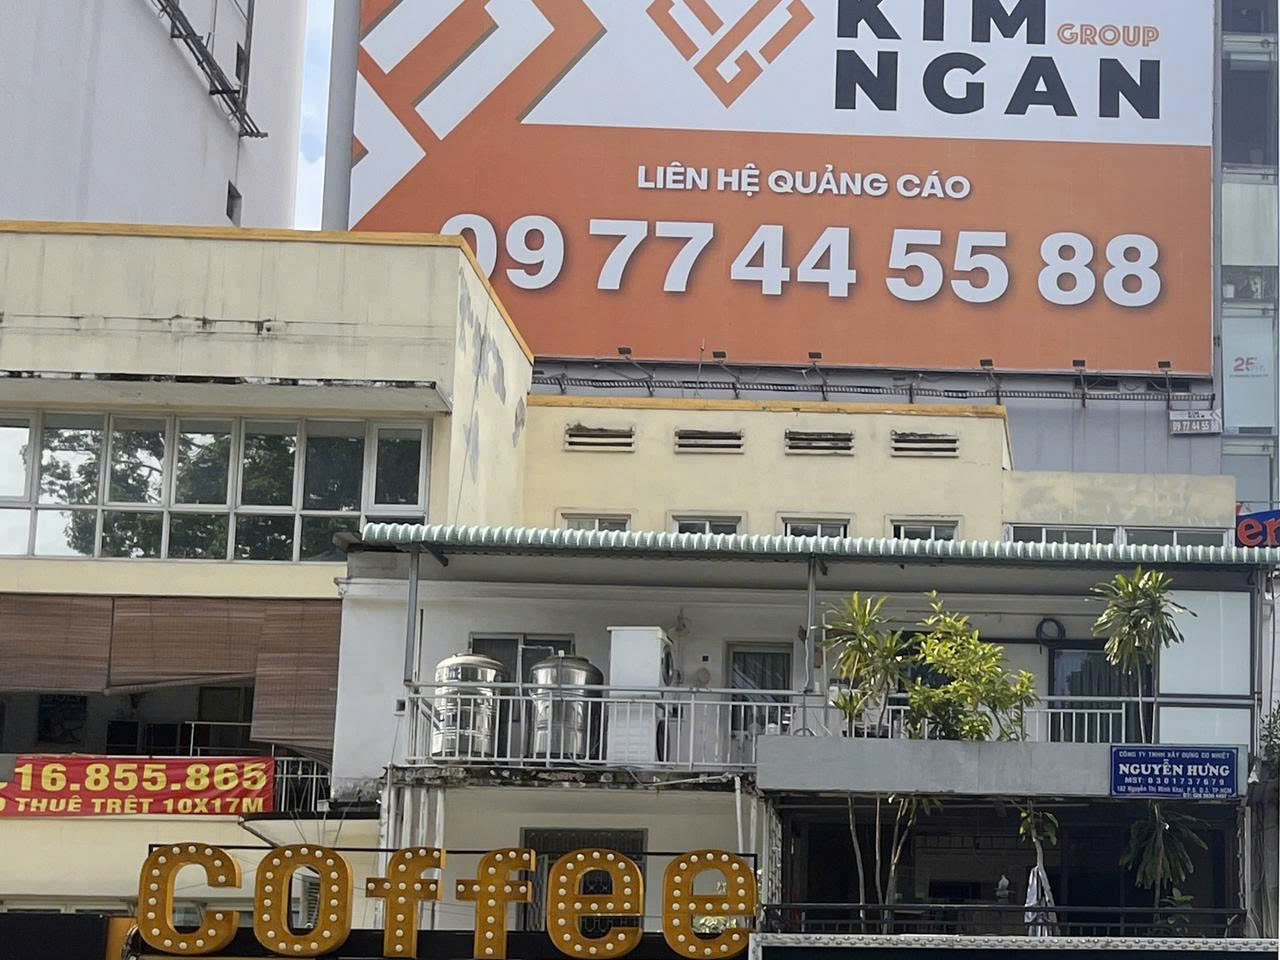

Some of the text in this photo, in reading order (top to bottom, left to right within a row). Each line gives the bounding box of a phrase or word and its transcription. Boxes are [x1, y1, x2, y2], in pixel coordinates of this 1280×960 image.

[837, 0, 1045, 44] KIM
[1057, 23, 1160, 47] GROUP
[835, 49, 1160, 119] NGAN
[637, 161, 971, 200] LIÊN HỆ QUẢNG CÁO
[439, 213, 1162, 307] 09 77 44 55 88
[0, 763, 267, 792] 16.855.865
[1119, 759, 1230, 776] NGUYỄN HƯNG
[15, 795, 82, 812] THUÊ
[163, 797, 264, 814] 10X17M
